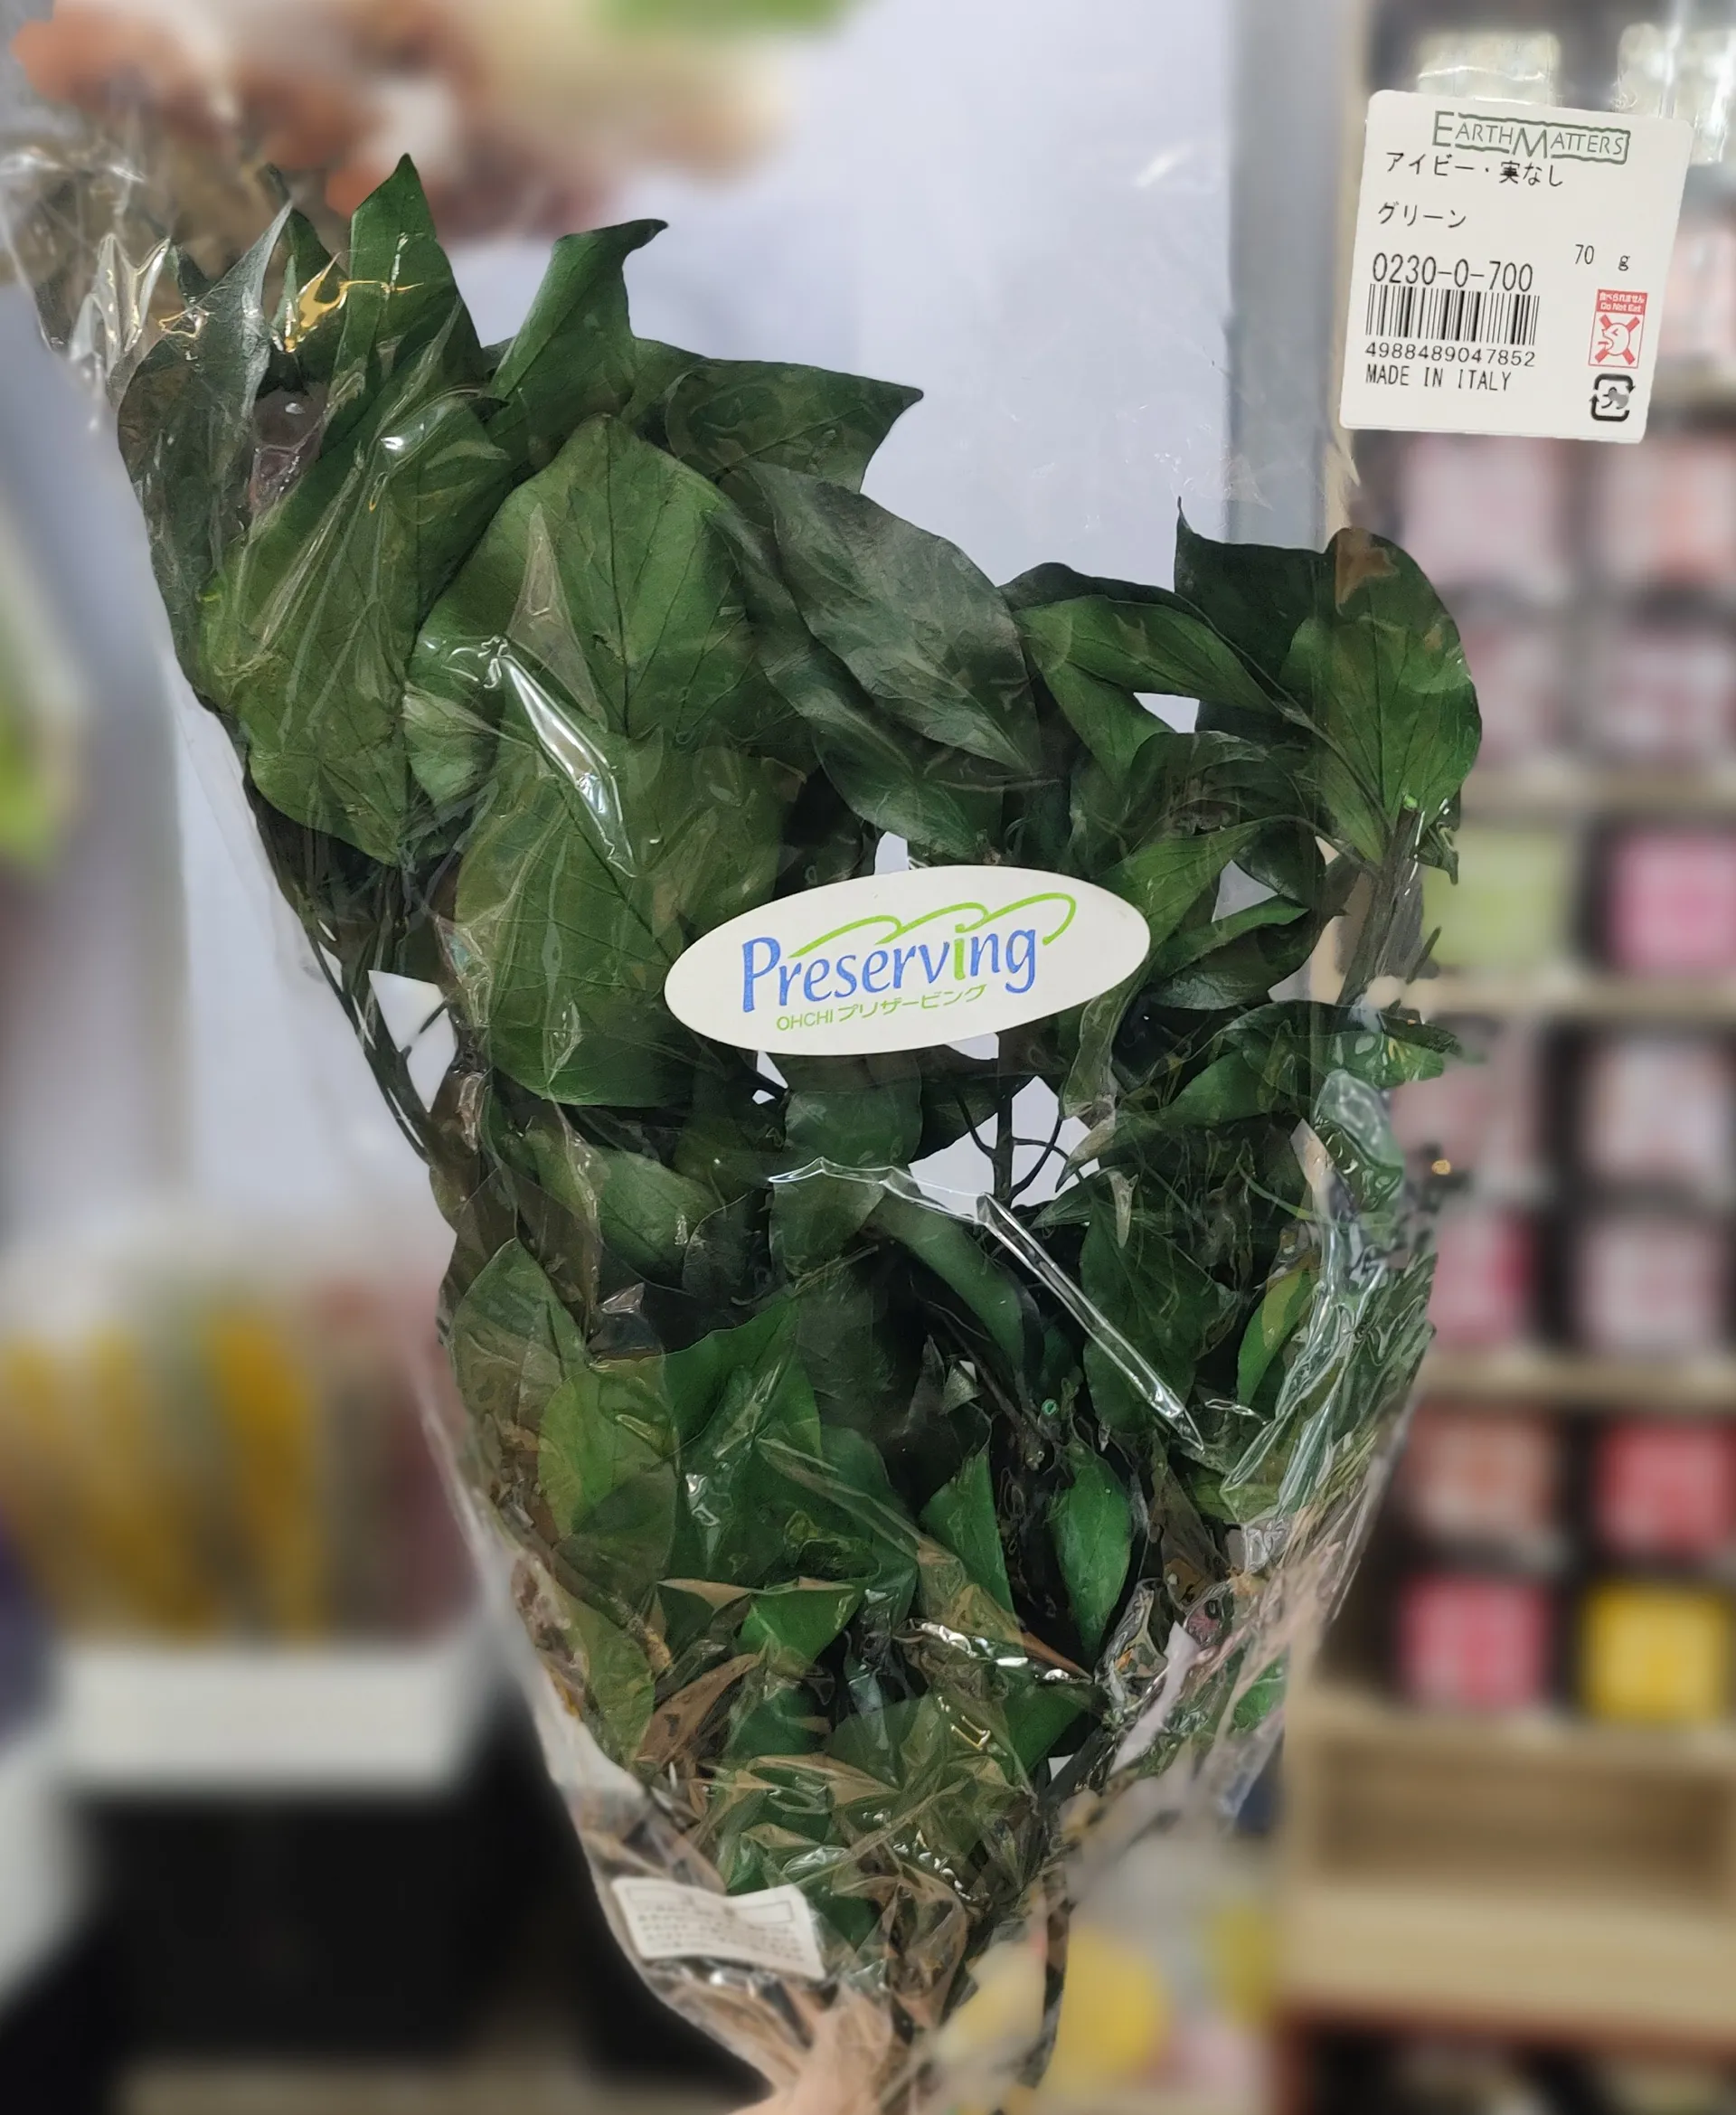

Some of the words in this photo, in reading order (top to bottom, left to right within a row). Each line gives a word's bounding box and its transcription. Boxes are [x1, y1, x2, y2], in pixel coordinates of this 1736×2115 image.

[1385, 151, 1564, 187] アイビー・実なし
[1378, 201, 1467, 228] グリーン
[1575, 244, 1595, 265] 70
[1618, 254, 1630, 271] g
[1373, 252, 1533, 292] 0230-0-700
[1599, 292, 1644, 303] 食べられません
[1600, 302, 1611, 310] Do
[1612, 303, 1627, 312] Not
[1628, 304, 1642, 313] Eat
[1364, 342, 1536, 367] 4988489047852
[1365, 364, 1410, 386] MADE
[1423, 366, 1444, 388] IN
[1458, 369, 1512, 392] ITALY
[742, 923, 1037, 1013] Preserving
[776, 1009, 834, 1032] OHCHI
[838, 984, 987, 1023] プリザービング
